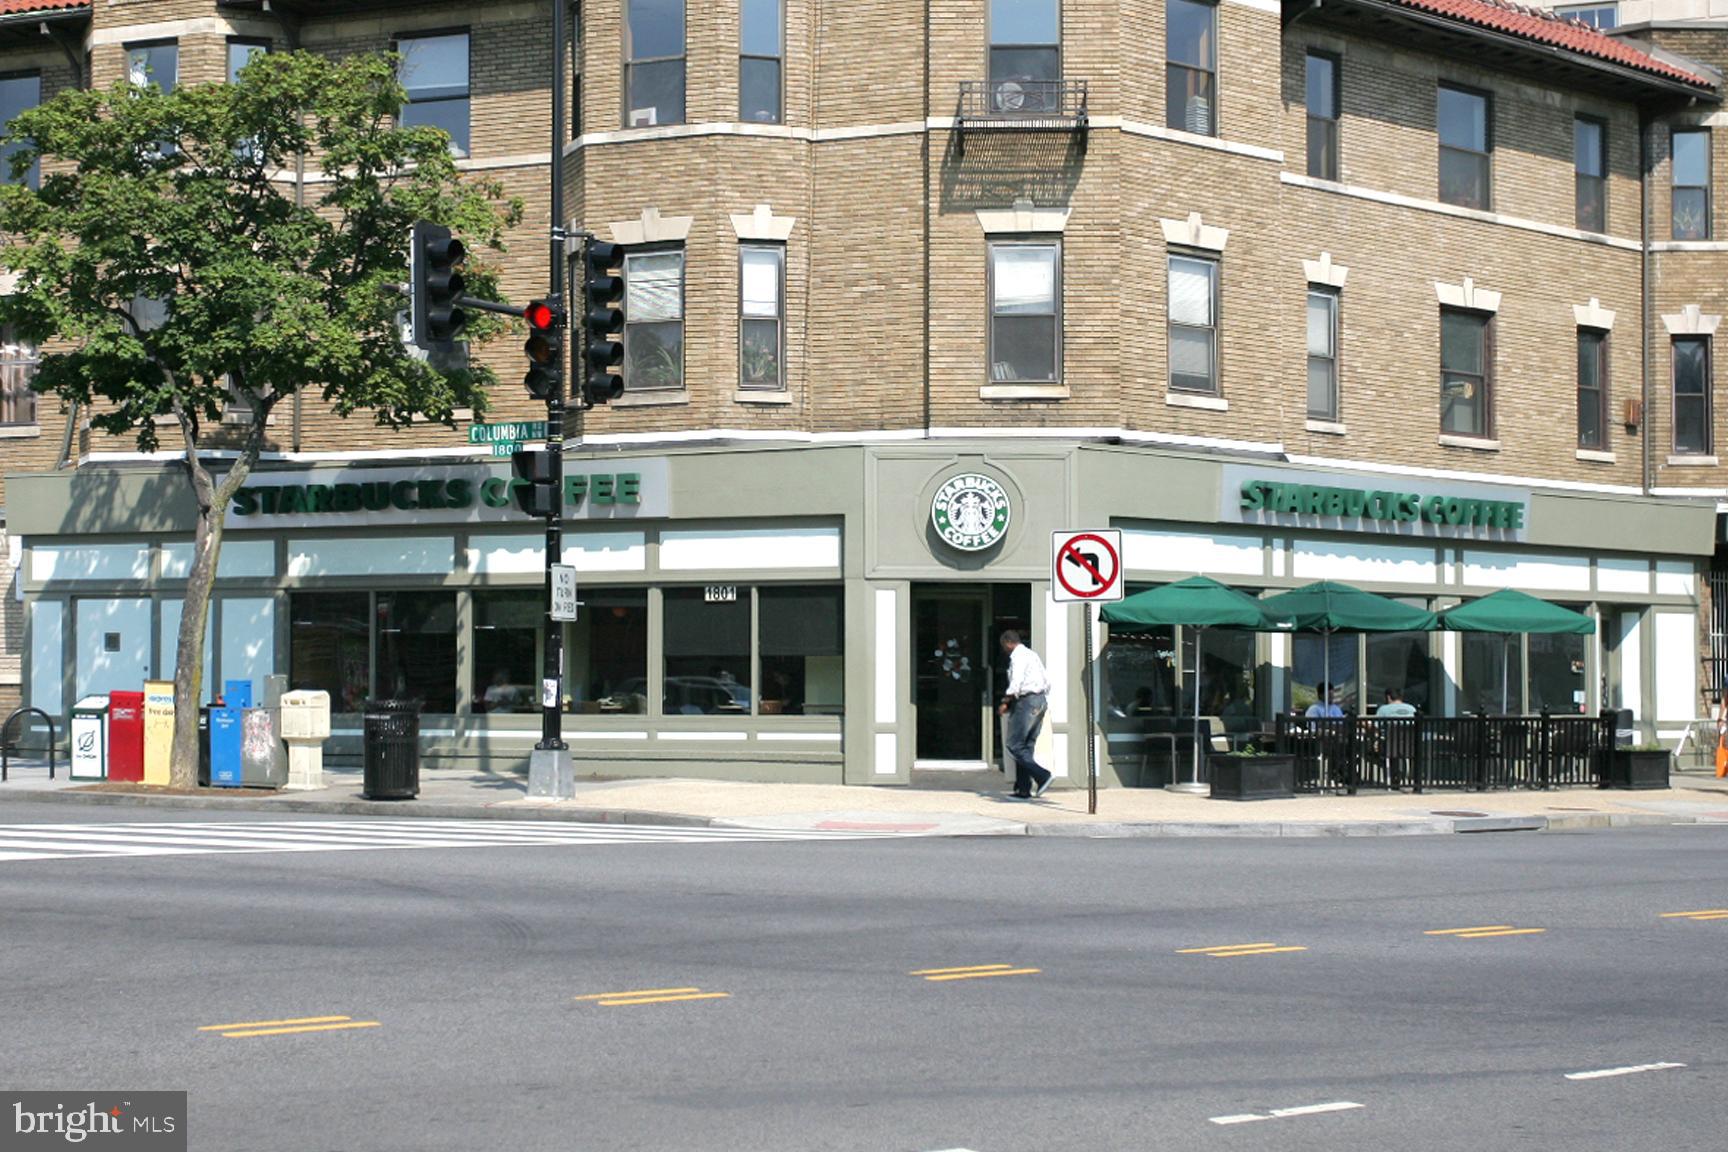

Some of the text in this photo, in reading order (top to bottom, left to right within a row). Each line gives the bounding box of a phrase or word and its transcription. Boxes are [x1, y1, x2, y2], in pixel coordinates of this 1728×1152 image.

[471, 424, 528, 441] COLUMBIA
[494, 444, 522, 456] 1800
[232, 473, 641, 516] STARBUCKS CFEE
[934, 476, 1006, 511] STARBUCKS
[1240, 480, 1525, 529] STARBUCKS COFFEE
[944, 527, 1000, 546] COFFEE
[558, 573, 570, 585] NO
[707, 585, 735, 600] 1801
